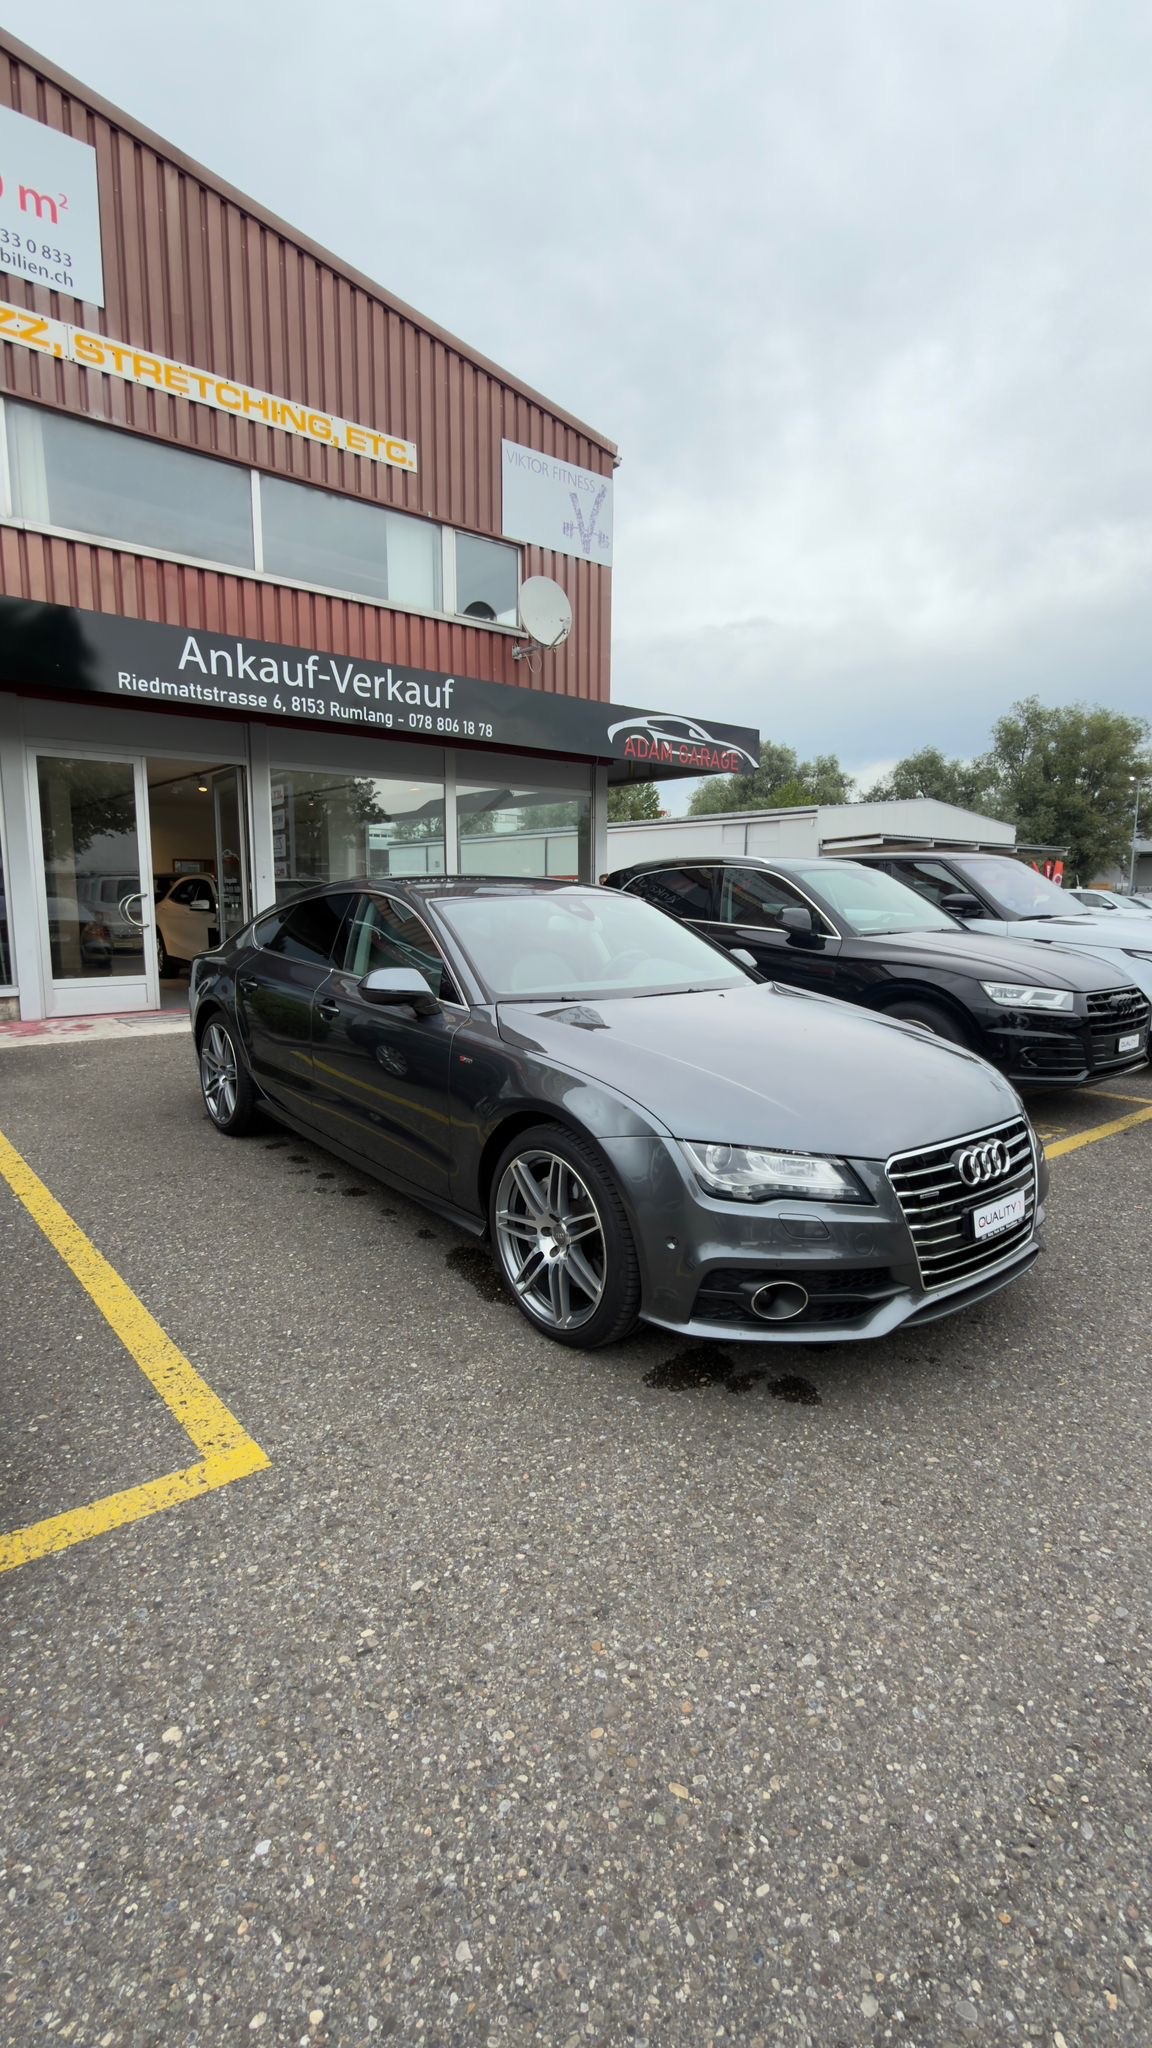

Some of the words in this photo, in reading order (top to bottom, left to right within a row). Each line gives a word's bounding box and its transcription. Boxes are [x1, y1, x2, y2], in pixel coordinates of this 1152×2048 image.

[0, 247, 74, 288] bilien.ch
[26, 239, 36, 254] 0
[41, 245, 72, 268] 833
[73, 333, 340, 448] STRETCHING,
[346, 426, 415, 468] ETC.
[506, 450, 550, 479] VIKTOR
[552, 465, 596, 493] FITNESS
[178, 636, 455, 709] Ankauf-Verkauf
[117, 671, 268, 708] Riedmattstrasse
[273, 694, 287, 713] 6,
[291, 696, 326, 715] 8153
[330, 701, 393, 728] Rumlang
[409, 713, 433, 729] 078
[436, 717, 459, 733] 806
[463, 720, 475, 736] 18
[478, 722, 493, 738] 78
[624, 736, 673, 763] ADAM
[678, 744, 740, 771] GARAGE
[978, 1201, 1017, 1229] QUALITY
